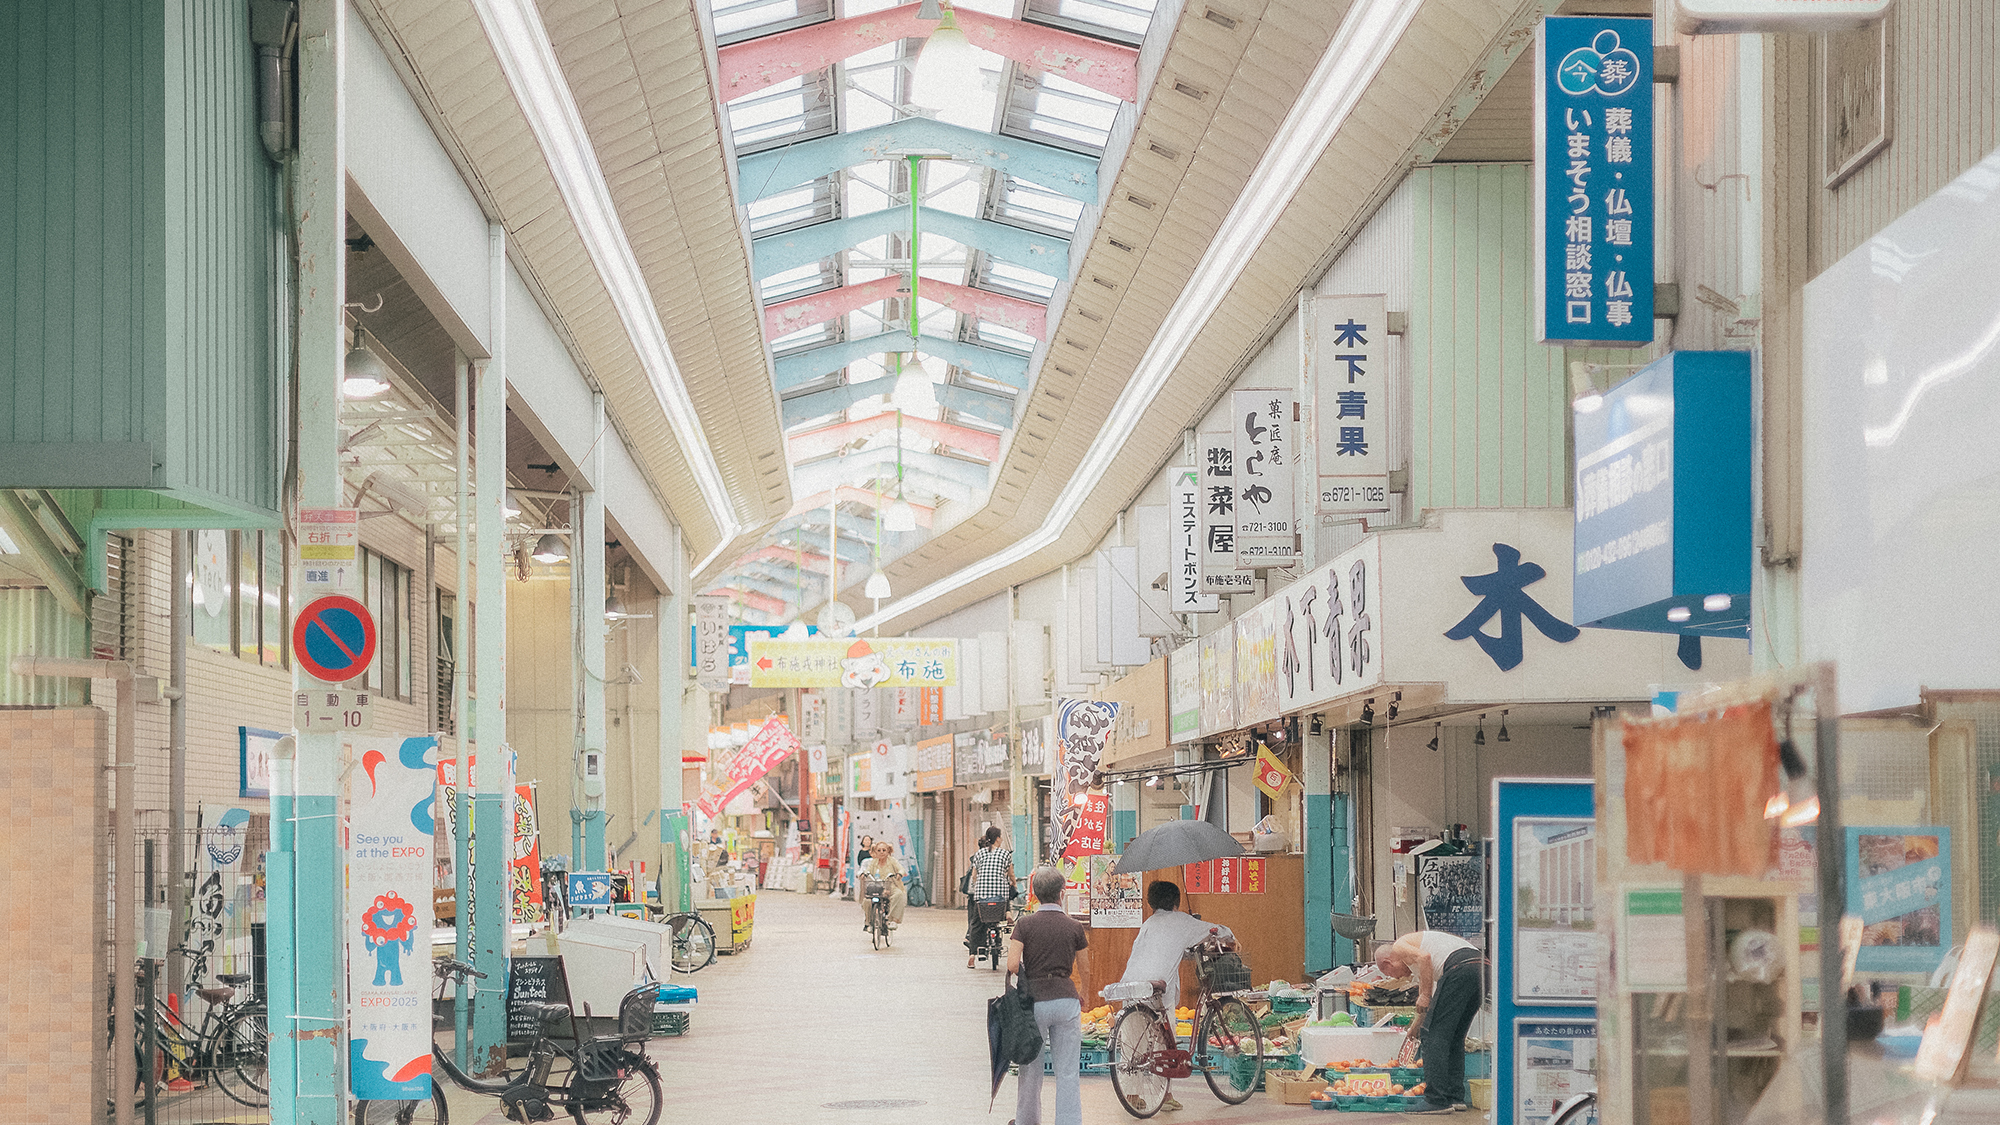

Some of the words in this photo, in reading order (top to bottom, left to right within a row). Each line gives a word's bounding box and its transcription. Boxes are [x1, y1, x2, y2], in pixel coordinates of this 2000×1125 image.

[1564, 59, 1598, 83] 今
[1600, 59, 1631, 84] 葬
[1565, 107, 1593, 324] いまそう相談窓口
[1605, 107, 1633, 327] 葬儀・仏壇・仏事
[1333, 318, 1369, 457] 木下青果
[1268, 399, 1283, 466] 菓匠庵
[1206, 447, 1234, 553] 惣菜屋
[1331, 486, 1384, 502] 6721-1025
[1249, 521, 1287, 532] 721-3100
[308, 532, 330, 543] 右折
[1182, 492, 1198, 604] エステートボンズ
[306, 570, 328, 581] 直進
[1205, 575, 1252, 585] 布施壱号店
[896, 659, 945, 680] 布施
[297, 693, 369, 707] 自動車
[356, 834, 380, 844] See
[383, 836, 403, 846] you
[356, 848, 367, 858] at
[370, 848, 389, 858] the
[392, 847, 425, 858] EXPO
[1248, 860, 1259, 891] 焼そば
[1419, 858, 1439, 888] 圧倒
[361, 997, 418, 1007] EXPO2025
